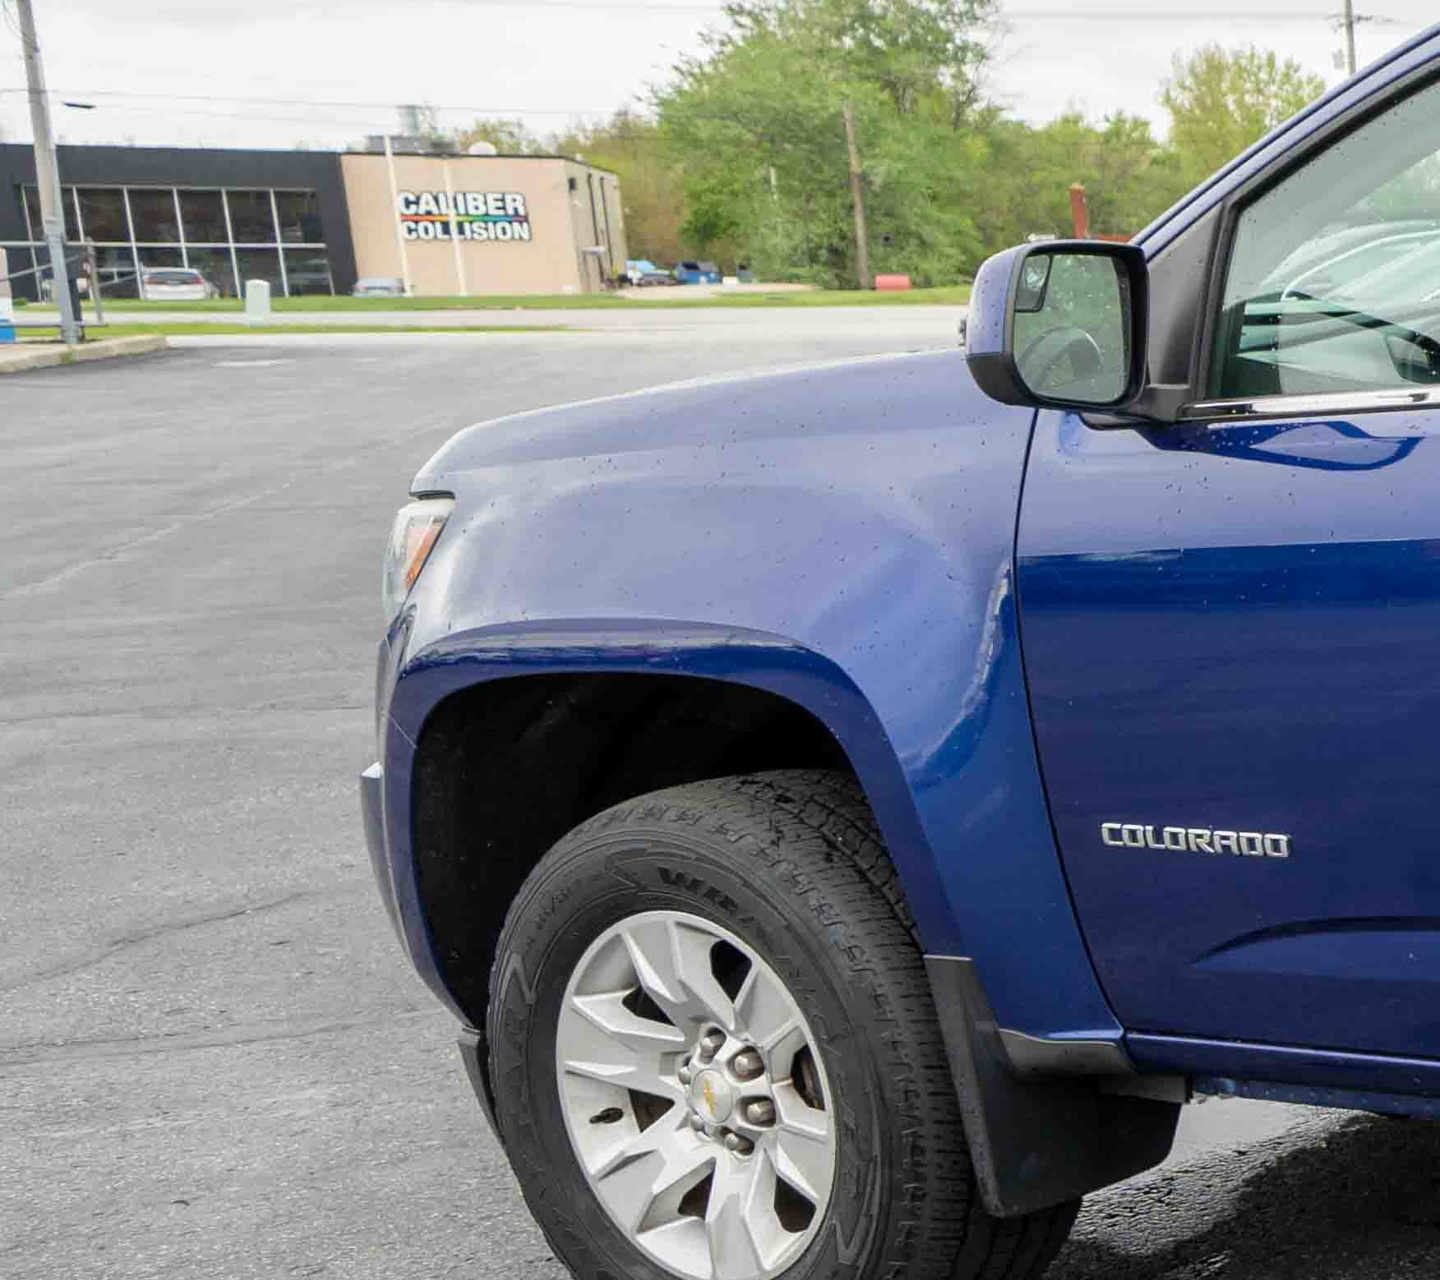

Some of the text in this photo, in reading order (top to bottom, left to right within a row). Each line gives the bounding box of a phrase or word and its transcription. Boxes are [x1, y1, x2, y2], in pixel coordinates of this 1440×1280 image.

[399, 191, 526, 216] CALIBER
[402, 220, 531, 241] COLLISION
[1101, 823, 1290, 858] COLORADO
